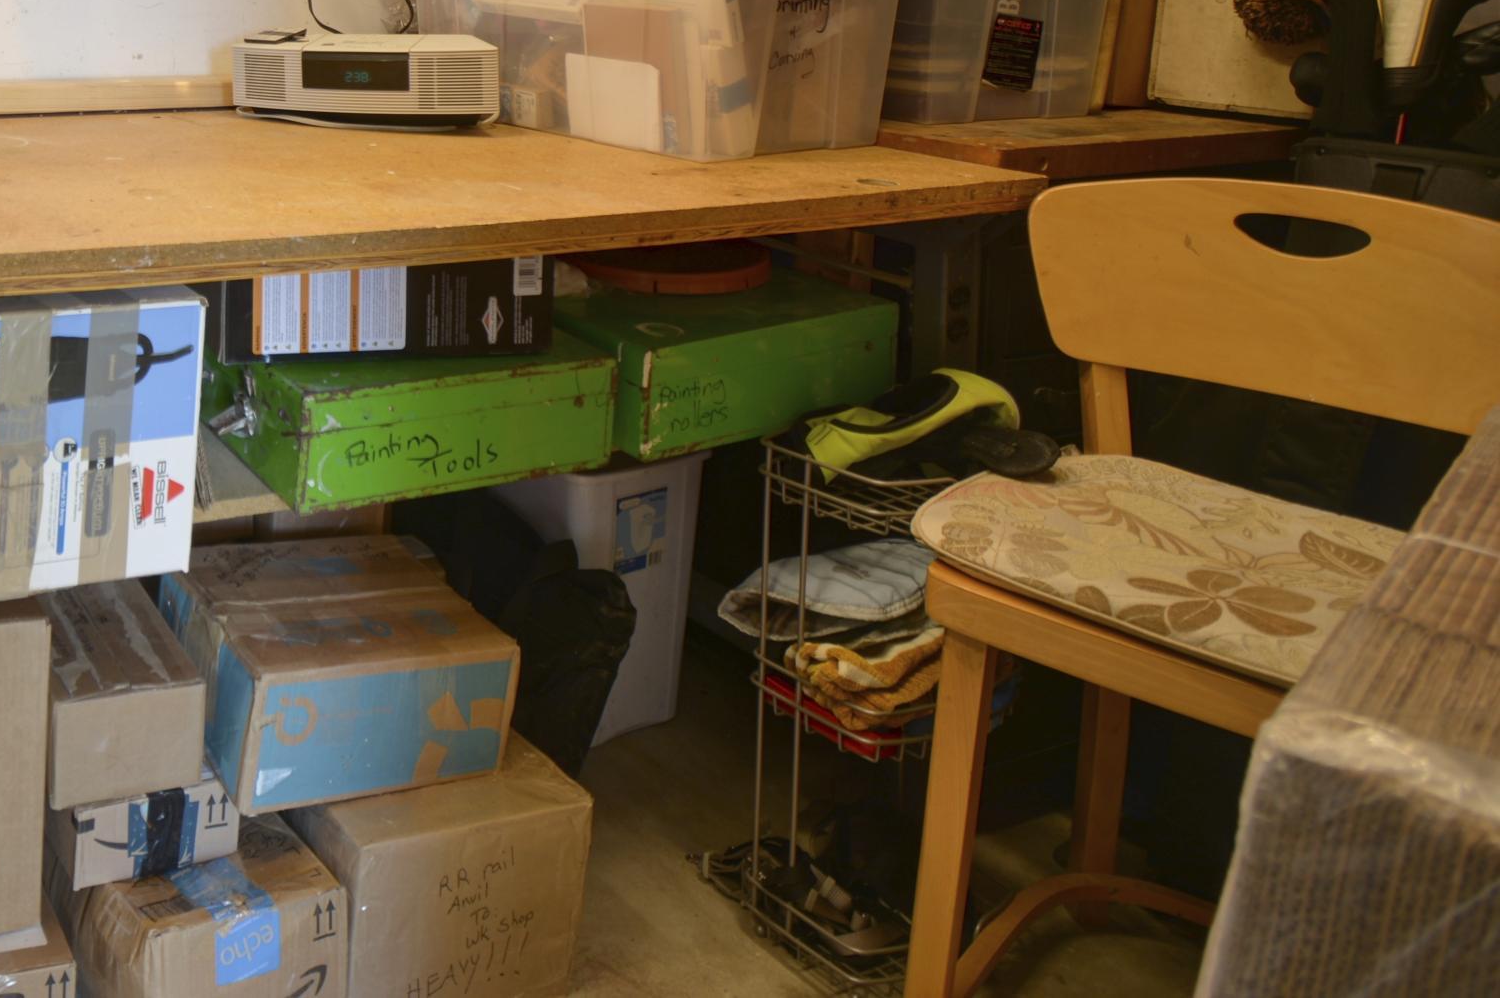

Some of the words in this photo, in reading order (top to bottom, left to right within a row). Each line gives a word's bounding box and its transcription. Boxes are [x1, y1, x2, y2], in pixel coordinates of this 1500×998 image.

[343, 433, 441, 470] Painting
[417, 439, 499, 478] Tools
[447, 882, 489, 915] Anvil
[219, 924, 274, 966] echo
